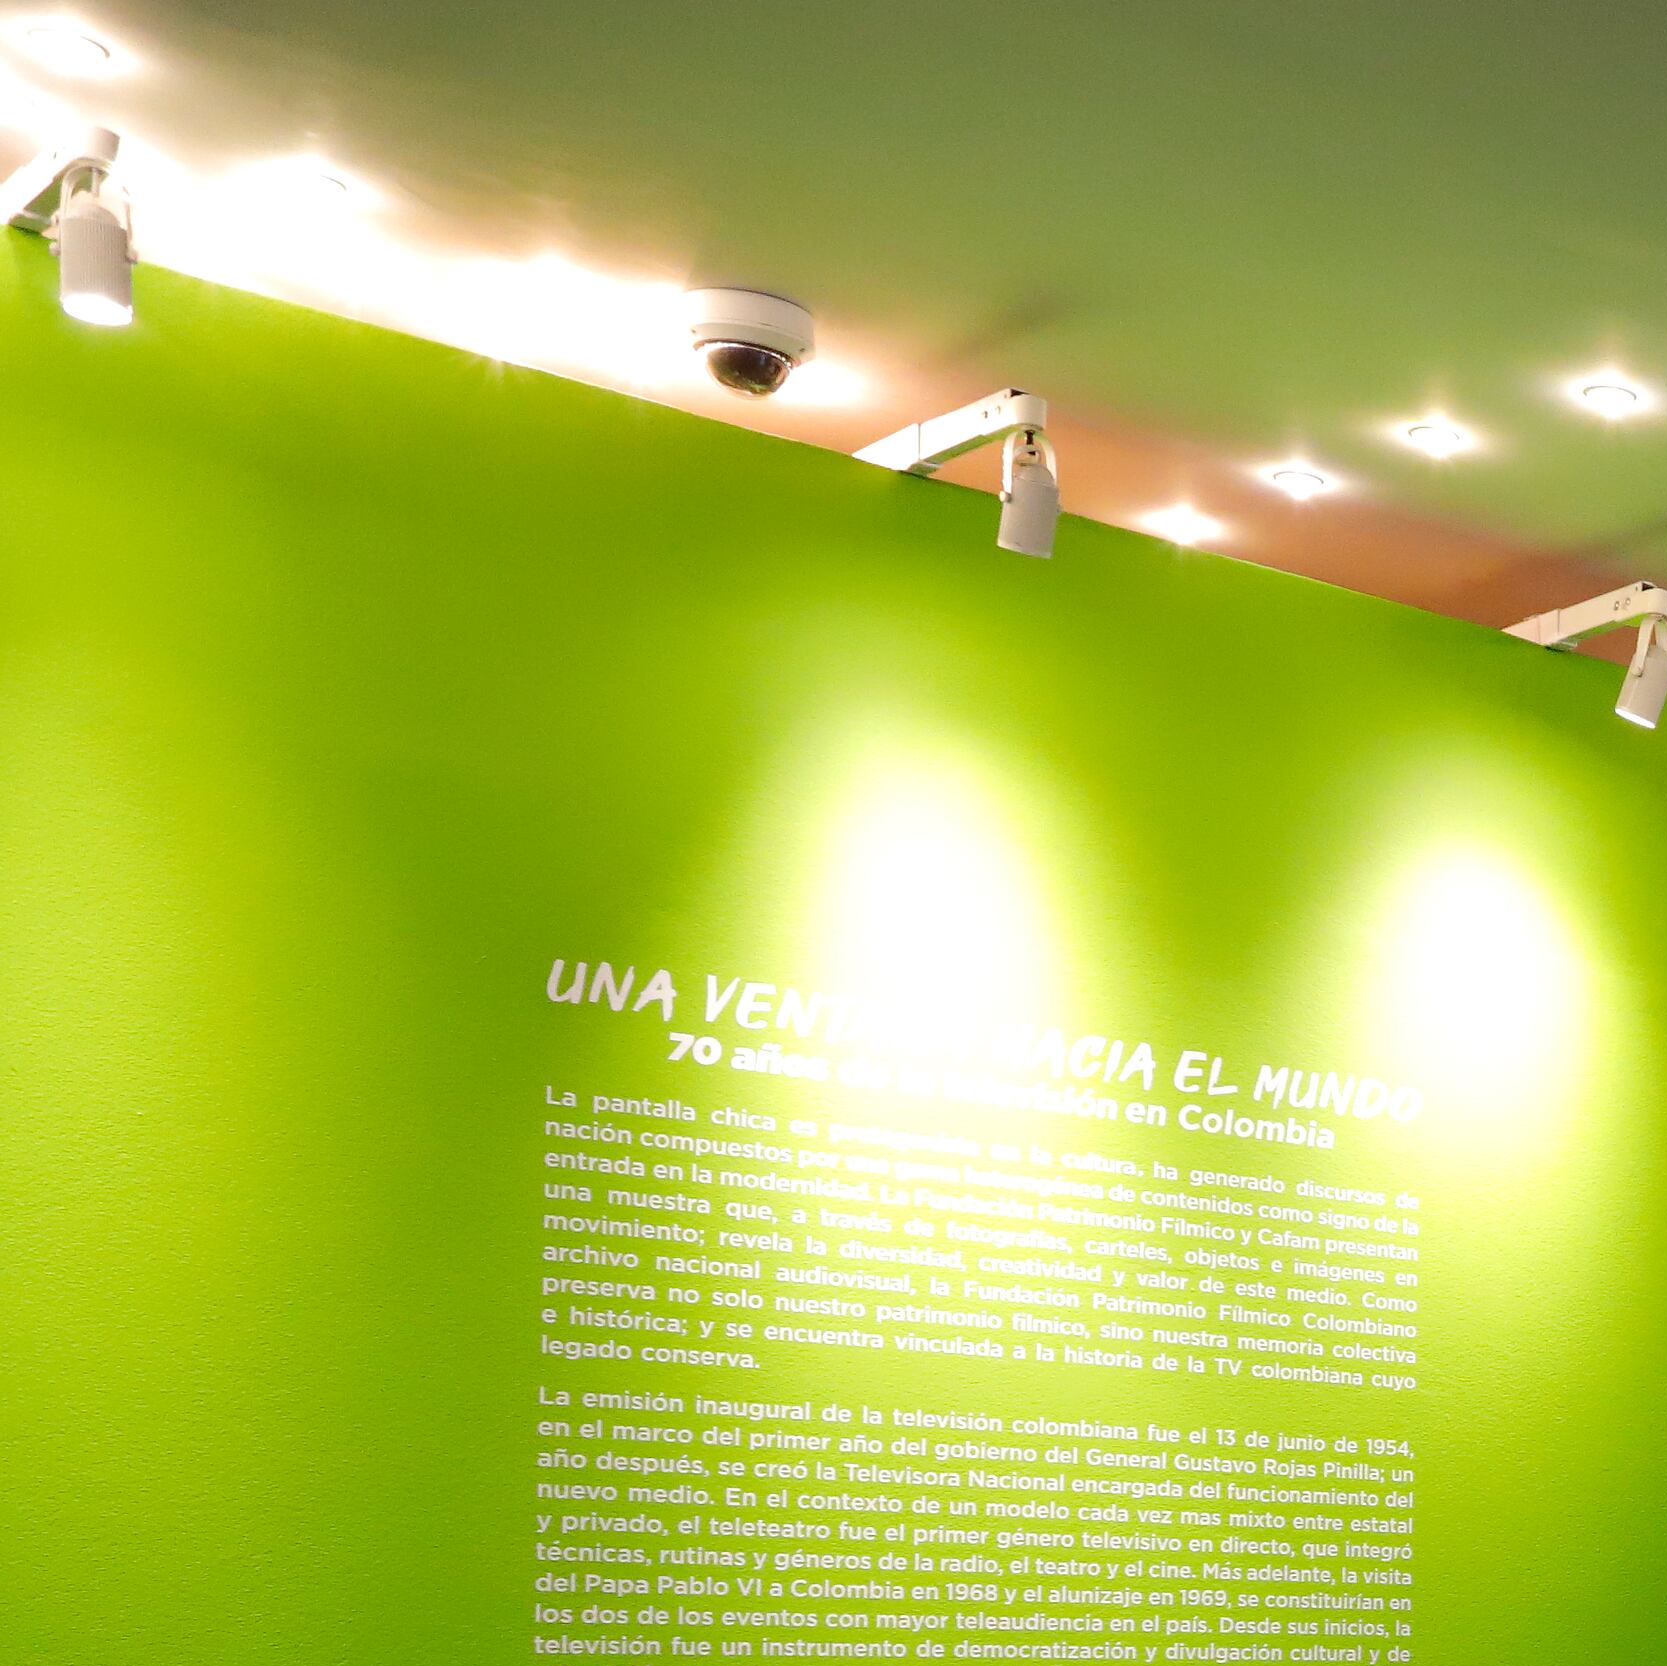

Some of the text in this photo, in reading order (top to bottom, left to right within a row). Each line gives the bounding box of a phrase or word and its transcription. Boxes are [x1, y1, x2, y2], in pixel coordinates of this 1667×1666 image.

[548, 959, 676, 1021] UNA
[1174, 1050, 1239, 1096] EL
[1253, 1064, 1424, 1122] MUNDO
[668, 1032, 723, 1065] 70
[730, 1043, 831, 1081] años
[1125, 1101, 1165, 1126] en
[1179, 1104, 1336, 1148] Colombia
[542, 1245, 1417, 1338] archivo nacional audiovisual, la Fundación Patrimonio Fílmico Colombiano
[541, 1337, 761, 1369] legado conserva.
[539, 1386, 1415, 1459] La emisión inaugural de la televisión colombiana fue el 13 de junio de 1954,
[534, 1635, 1411, 1665] televisión fue un instrumento de democratización y divulgación cultural y de
